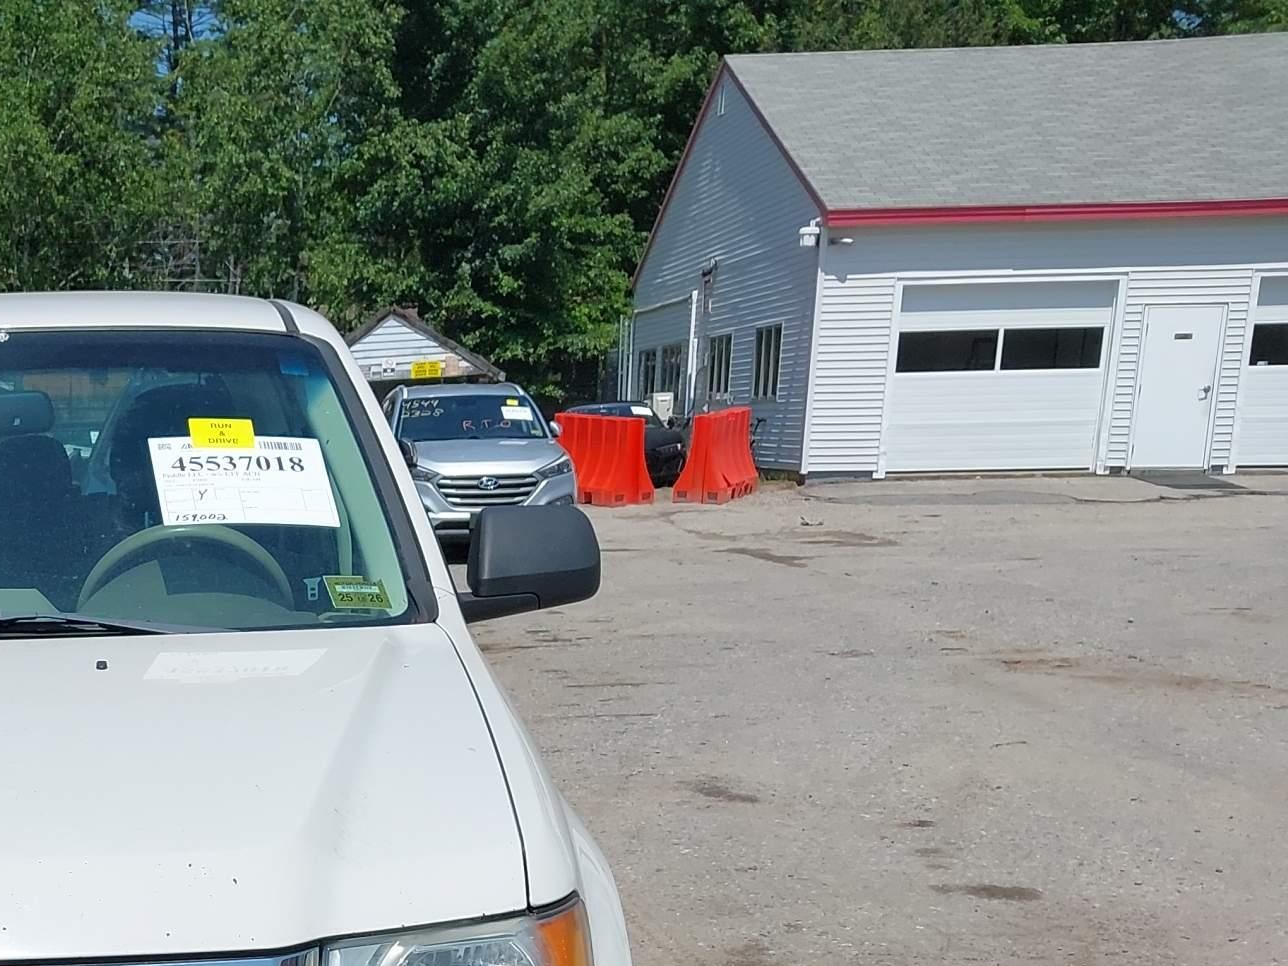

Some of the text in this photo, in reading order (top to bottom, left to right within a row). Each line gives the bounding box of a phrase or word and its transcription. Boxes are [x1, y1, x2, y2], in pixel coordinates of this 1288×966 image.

[210, 422, 232, 430] RUN
[208, 437, 239, 445] DRIVE
[170, 455, 305, 473] 45537018
[337, 592, 384, 603] 25 26
